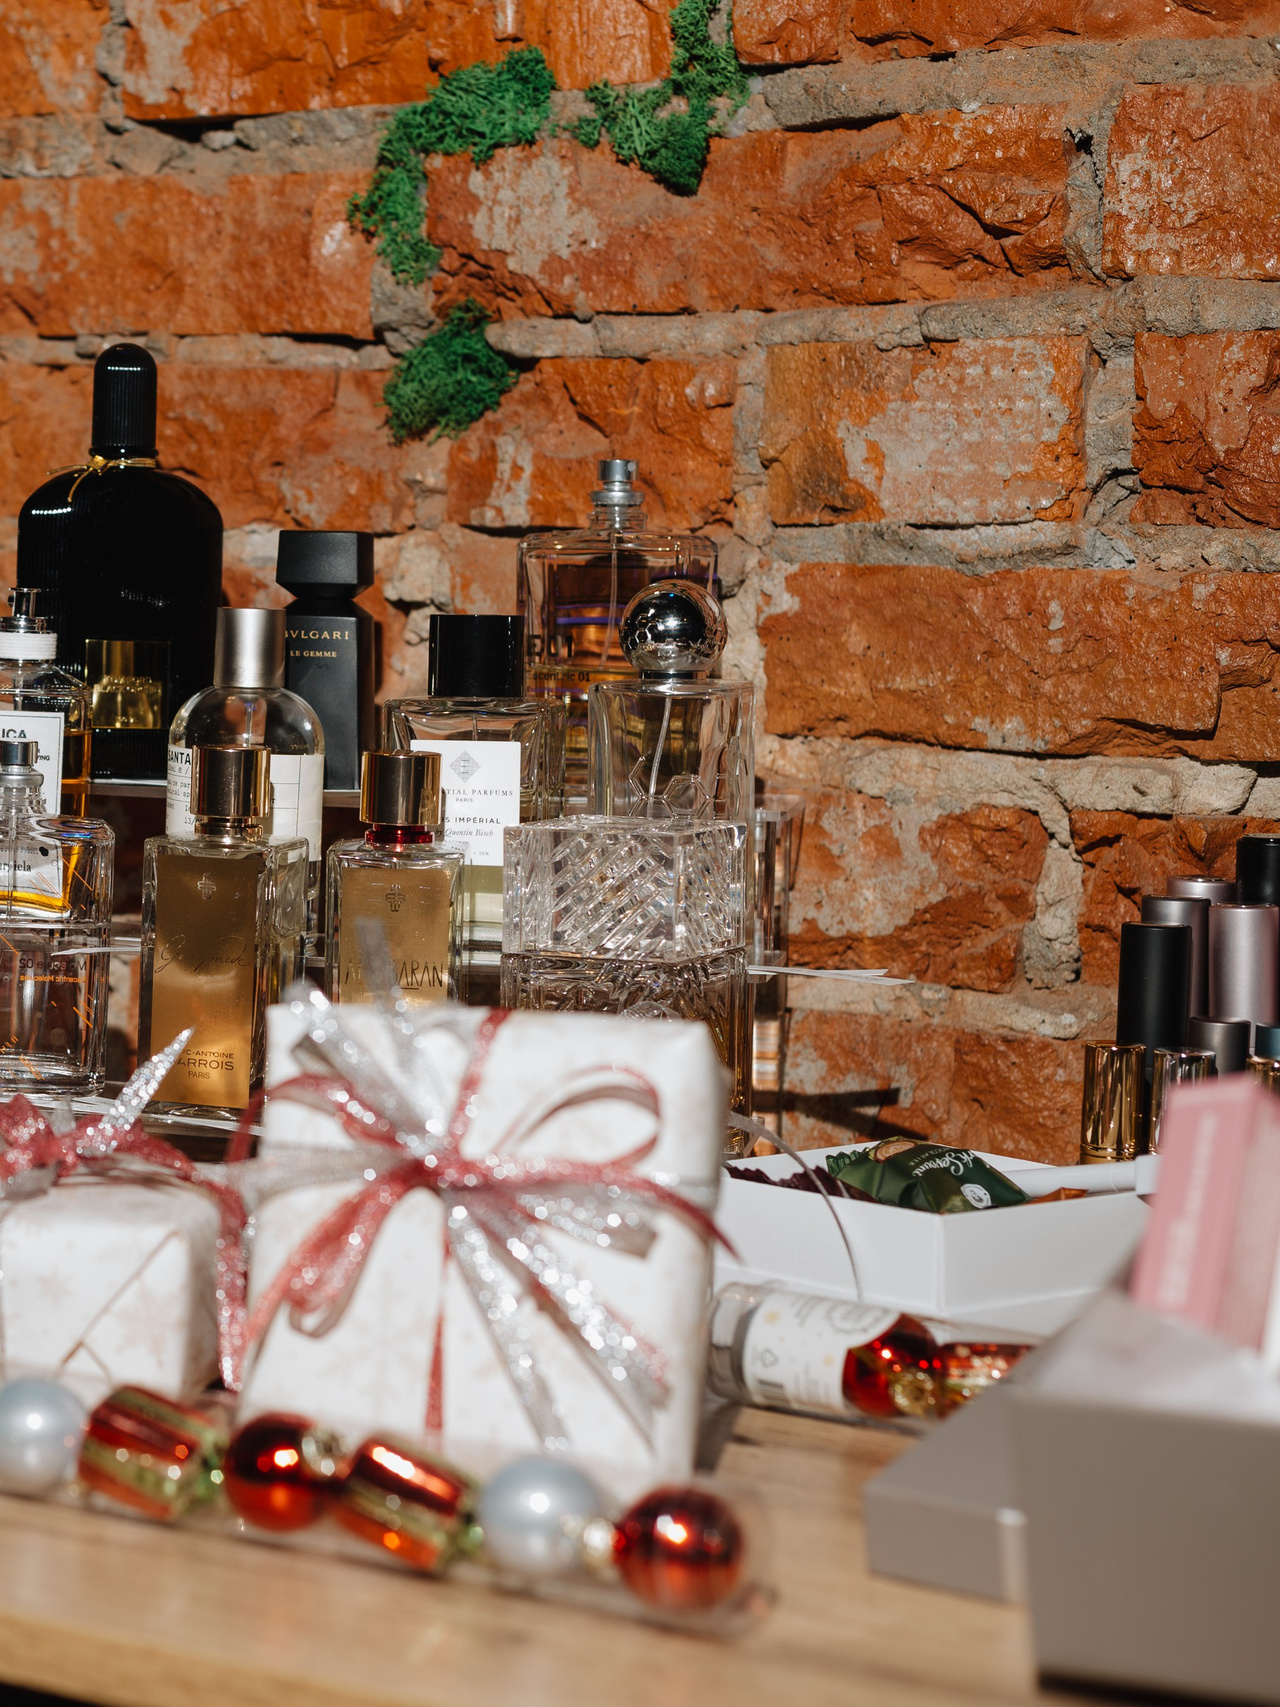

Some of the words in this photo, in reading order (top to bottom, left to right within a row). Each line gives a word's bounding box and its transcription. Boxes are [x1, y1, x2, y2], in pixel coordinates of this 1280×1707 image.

[168, 749, 191, 766] SANTA
[177, 1058, 234, 1071] ARROIS
[188, 1071, 211, 1080] PARIS
